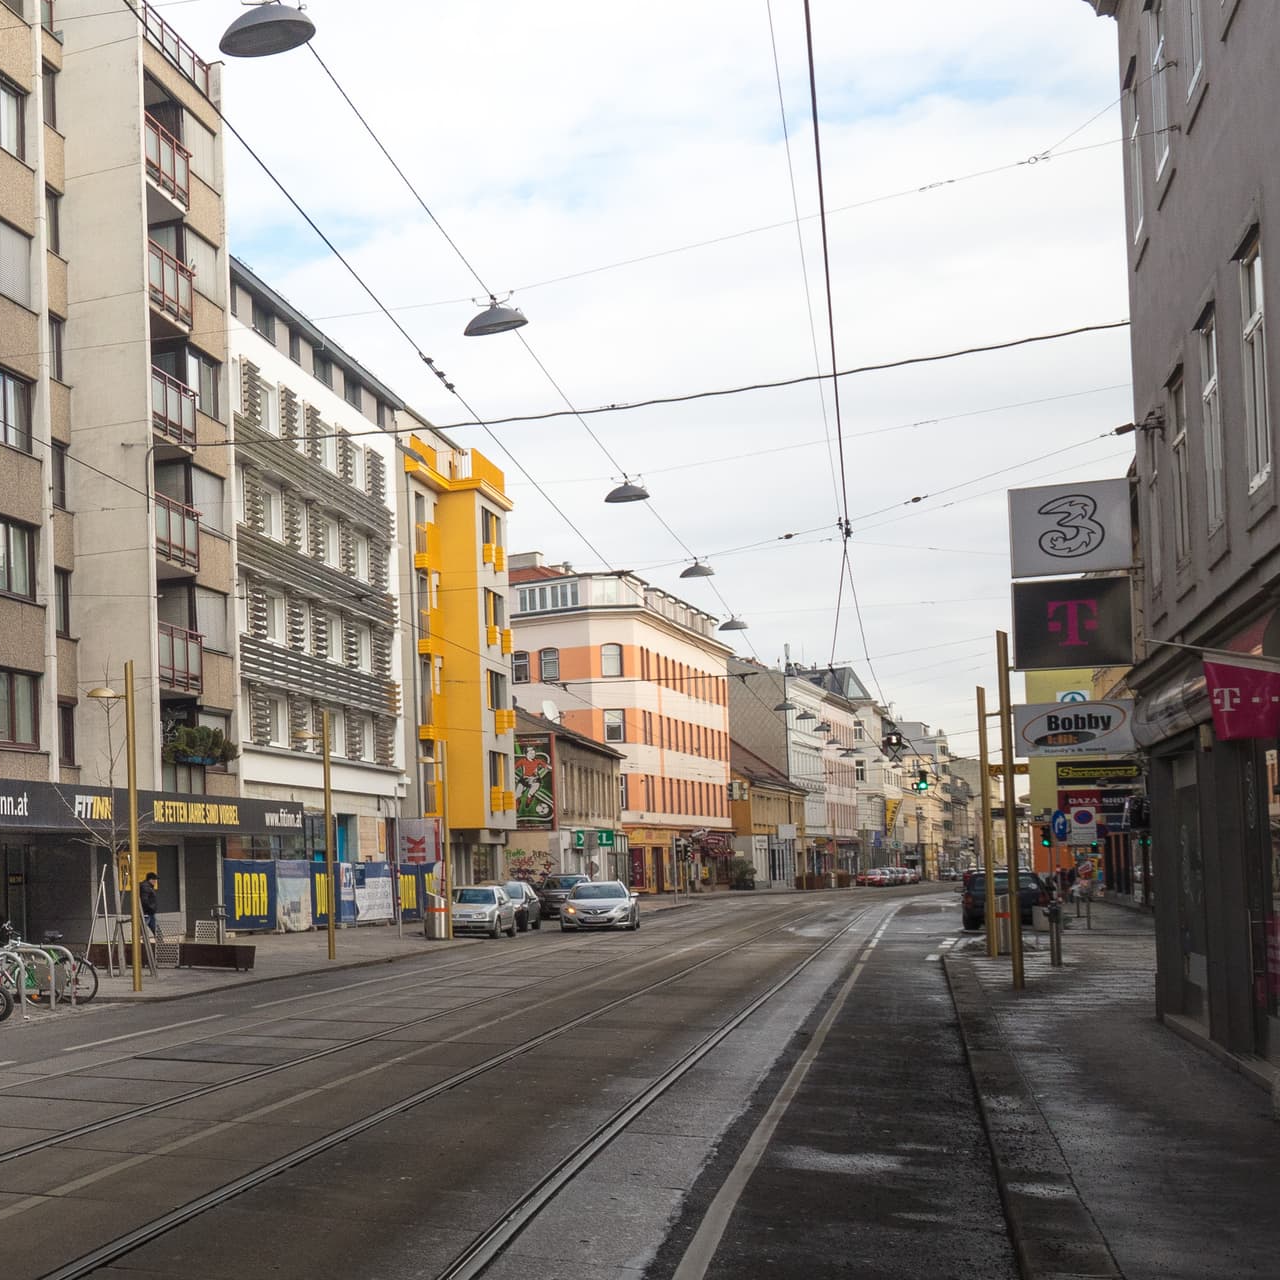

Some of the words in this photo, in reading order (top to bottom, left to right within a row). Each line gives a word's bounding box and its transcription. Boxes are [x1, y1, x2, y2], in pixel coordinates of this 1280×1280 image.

[1047, 713, 1112, 731] Bobby
[75, 795, 113, 819] FITINN
[265, 808, 302, 828] www.fitinn.at
